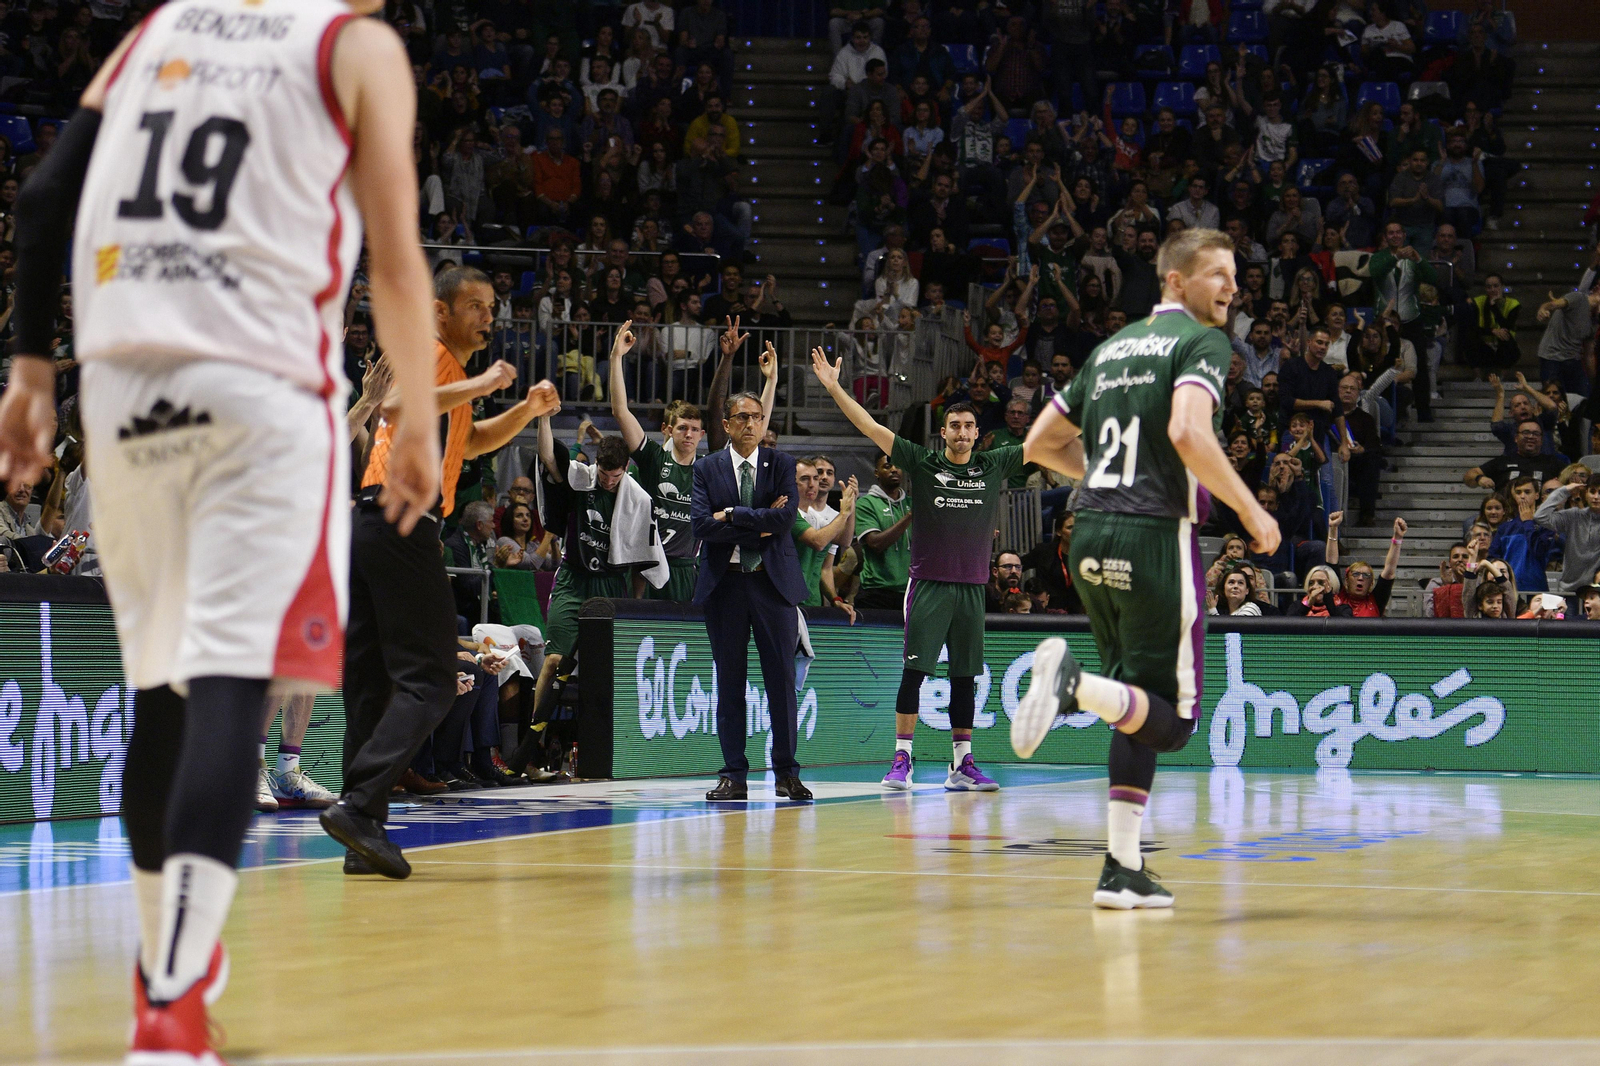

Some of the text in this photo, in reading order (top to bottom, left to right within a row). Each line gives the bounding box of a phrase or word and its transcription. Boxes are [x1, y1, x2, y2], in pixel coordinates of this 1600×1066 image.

[174, 7, 296, 41] BENZING
[117, 109, 250, 231] 19
[1088, 415, 1140, 489] 21
[957, 480, 986, 489] Unicaja
[662, 529, 676, 545] 7
[1209, 633, 1506, 768] Inglés
